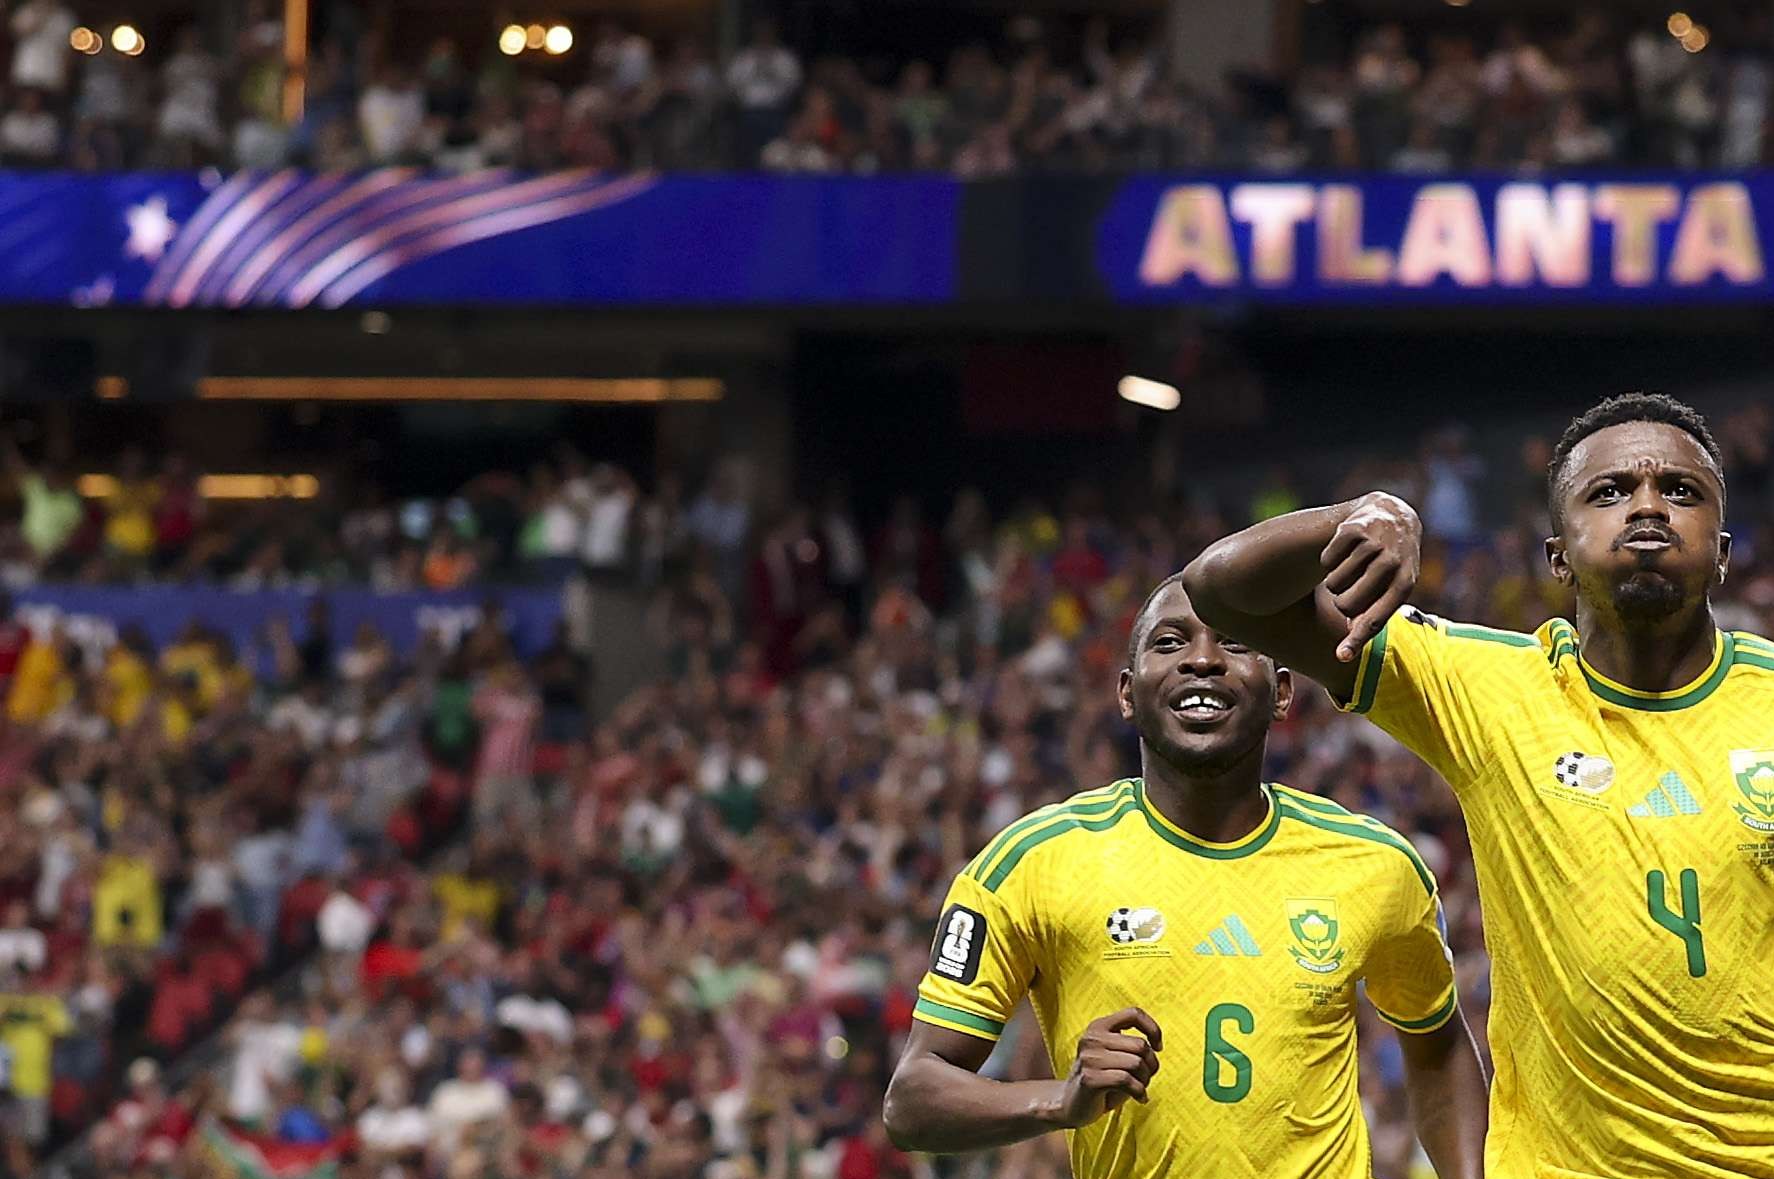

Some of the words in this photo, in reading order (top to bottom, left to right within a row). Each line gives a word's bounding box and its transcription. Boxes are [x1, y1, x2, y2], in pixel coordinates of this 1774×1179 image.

[1139, 182, 1766, 287] ATLANTA
[1646, 868, 1707, 978] 4
[1203, 1002, 1255, 1103] 6
